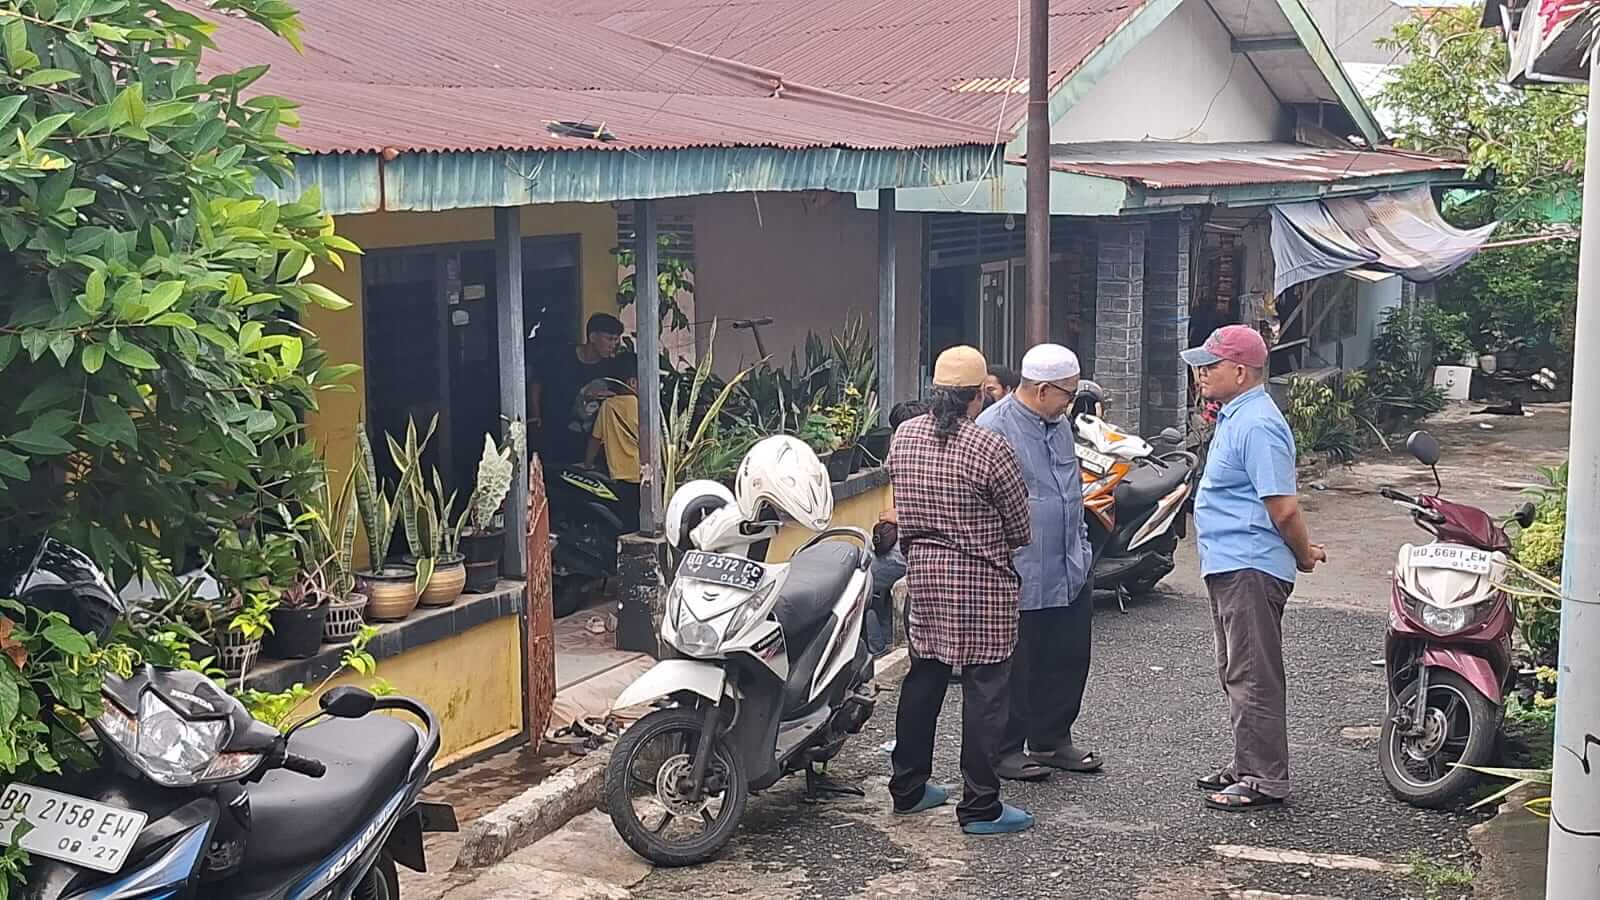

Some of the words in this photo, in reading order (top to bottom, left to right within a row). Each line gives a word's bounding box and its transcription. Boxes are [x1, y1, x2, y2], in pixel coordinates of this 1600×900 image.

[706, 555, 740, 572] 2572
[1470, 551, 1487, 562] EW
[169, 688, 216, 713] HONDA
[38, 798, 95, 829] 2158
[97, 812, 134, 839] EW
